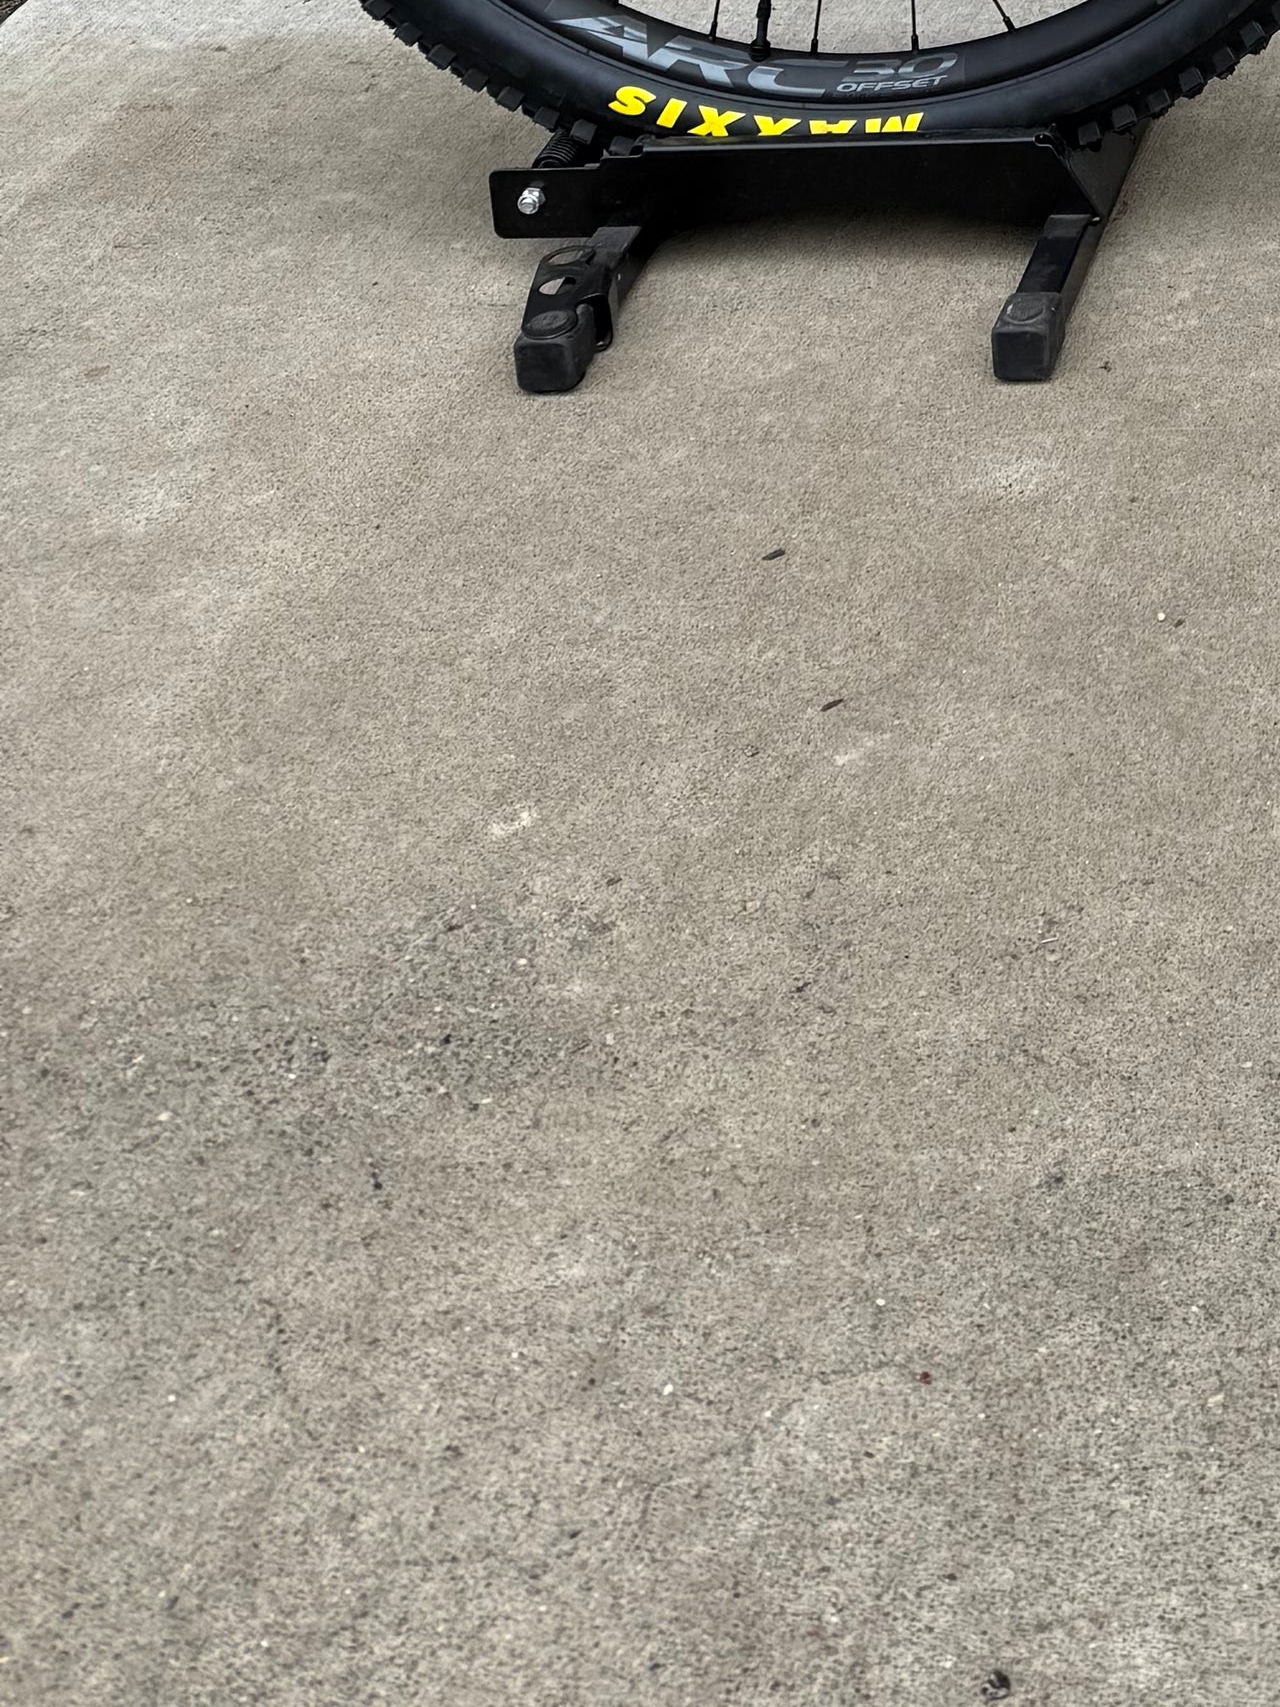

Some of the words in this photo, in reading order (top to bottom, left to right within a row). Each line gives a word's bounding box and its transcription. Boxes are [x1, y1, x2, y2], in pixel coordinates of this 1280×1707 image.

[553, 14, 849, 97] ARC
[848, 52, 958, 76] 30
[836, 74, 948, 93] OFFSET
